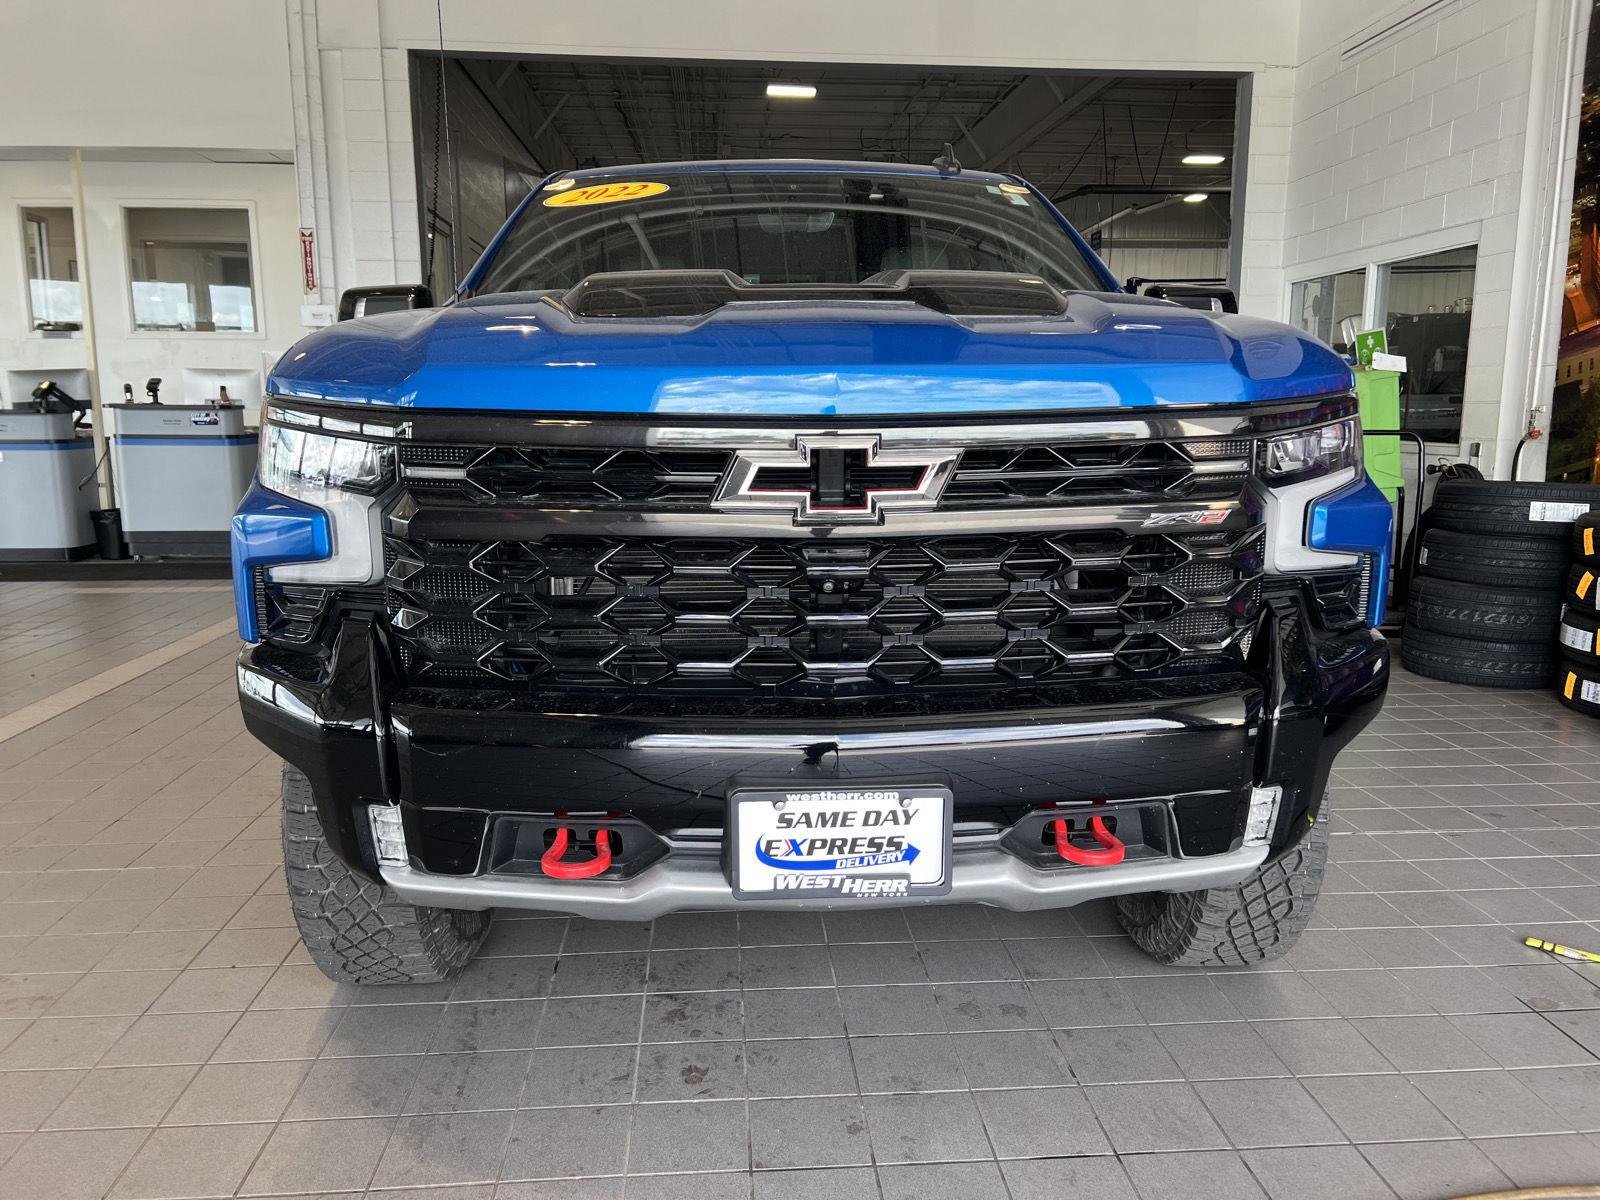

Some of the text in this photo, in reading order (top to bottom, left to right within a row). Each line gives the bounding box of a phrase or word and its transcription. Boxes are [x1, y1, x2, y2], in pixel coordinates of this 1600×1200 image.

[562, 184, 649, 204] 2022
[785, 791, 900, 801] westherr.com
[776, 808, 920, 829] SAME DAY
[763, 835, 906, 857] EXPRESS
[835, 850, 906, 869] DELIVERY
